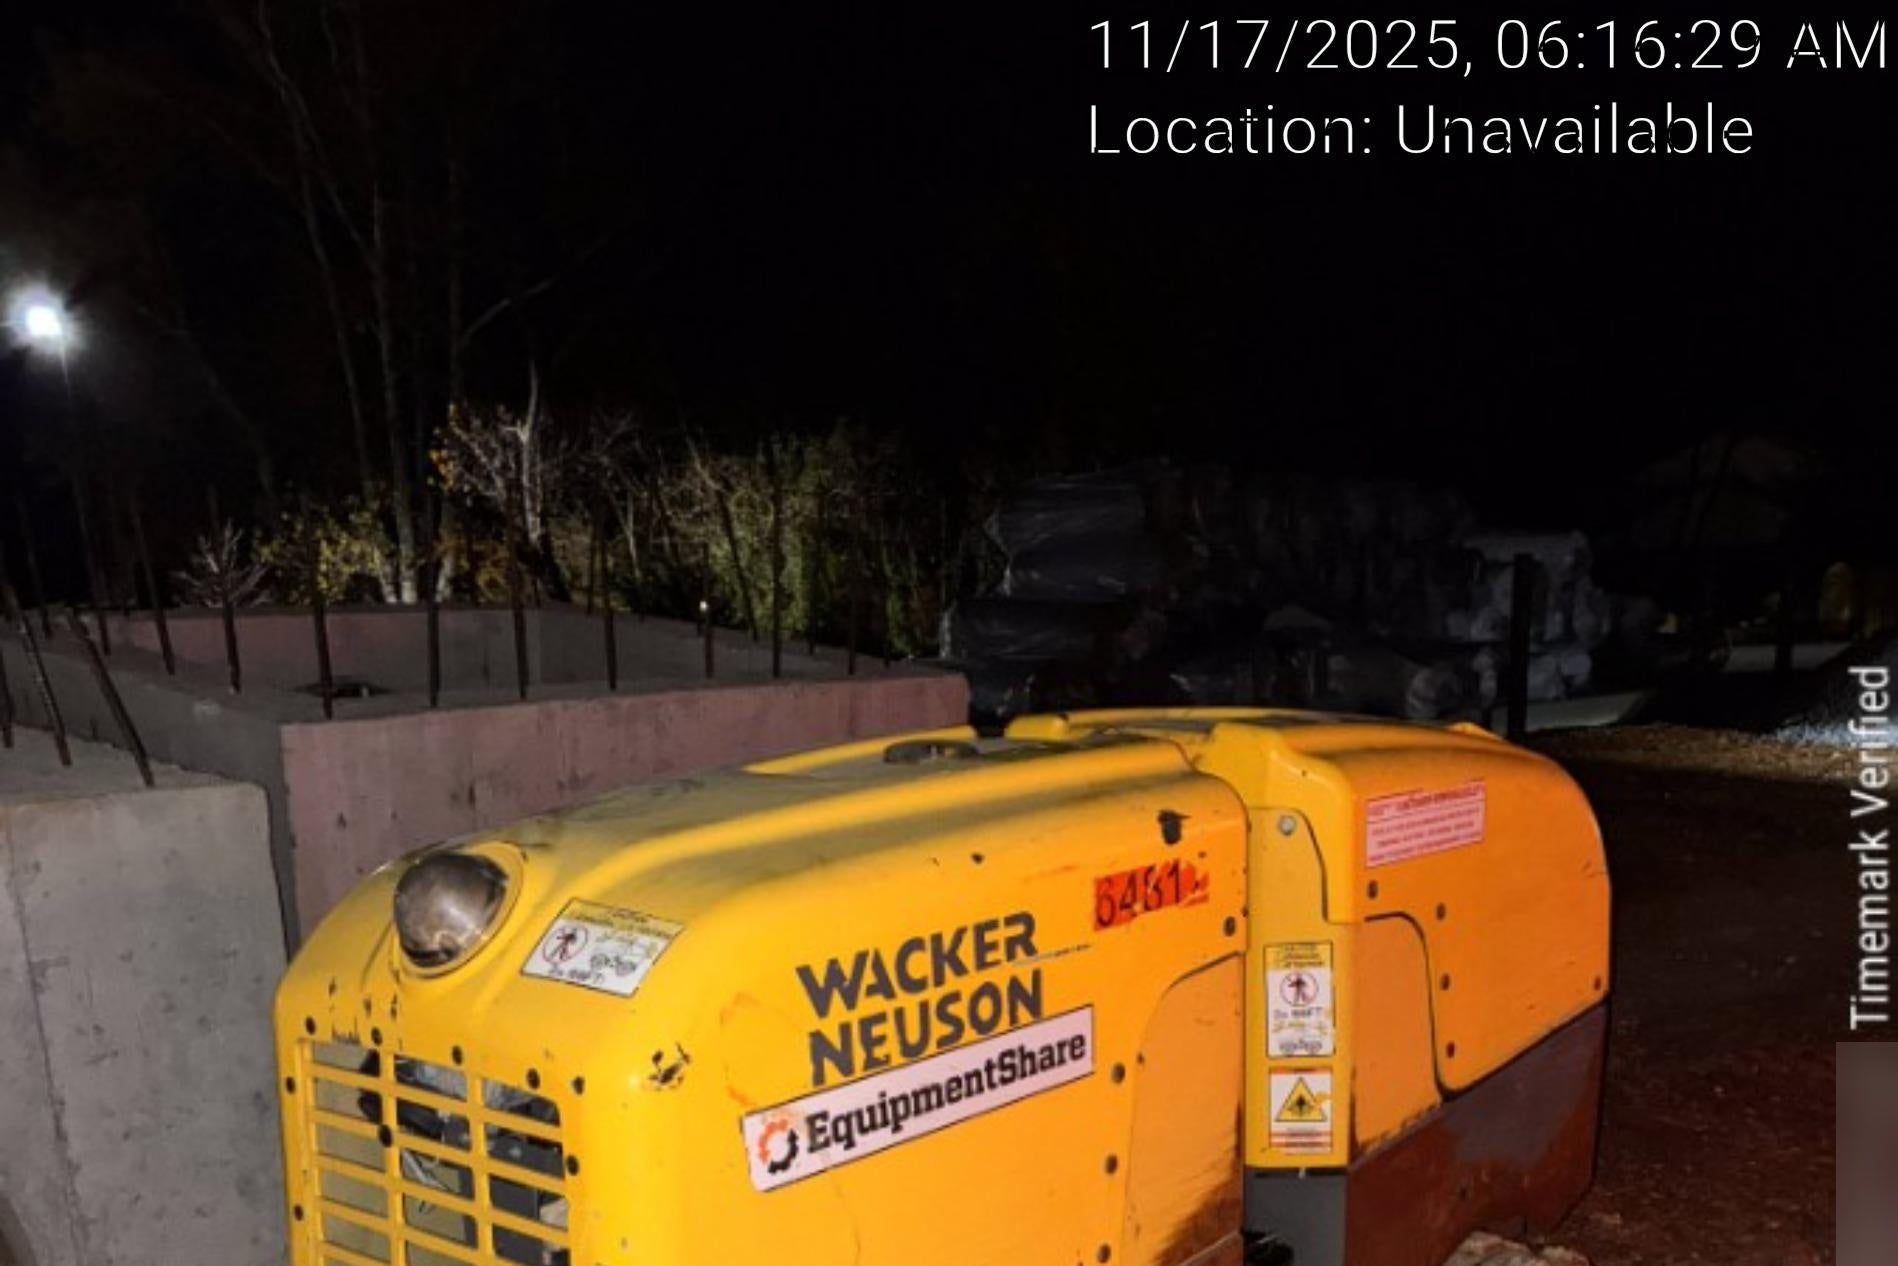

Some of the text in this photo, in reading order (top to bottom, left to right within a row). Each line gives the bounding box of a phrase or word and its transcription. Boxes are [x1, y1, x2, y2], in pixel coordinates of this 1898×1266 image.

[796, 911, 1038, 1019] WACKER
[808, 968, 1043, 1086] NEUSON
[805, 1032, 1086, 1154] EquipmentShare
